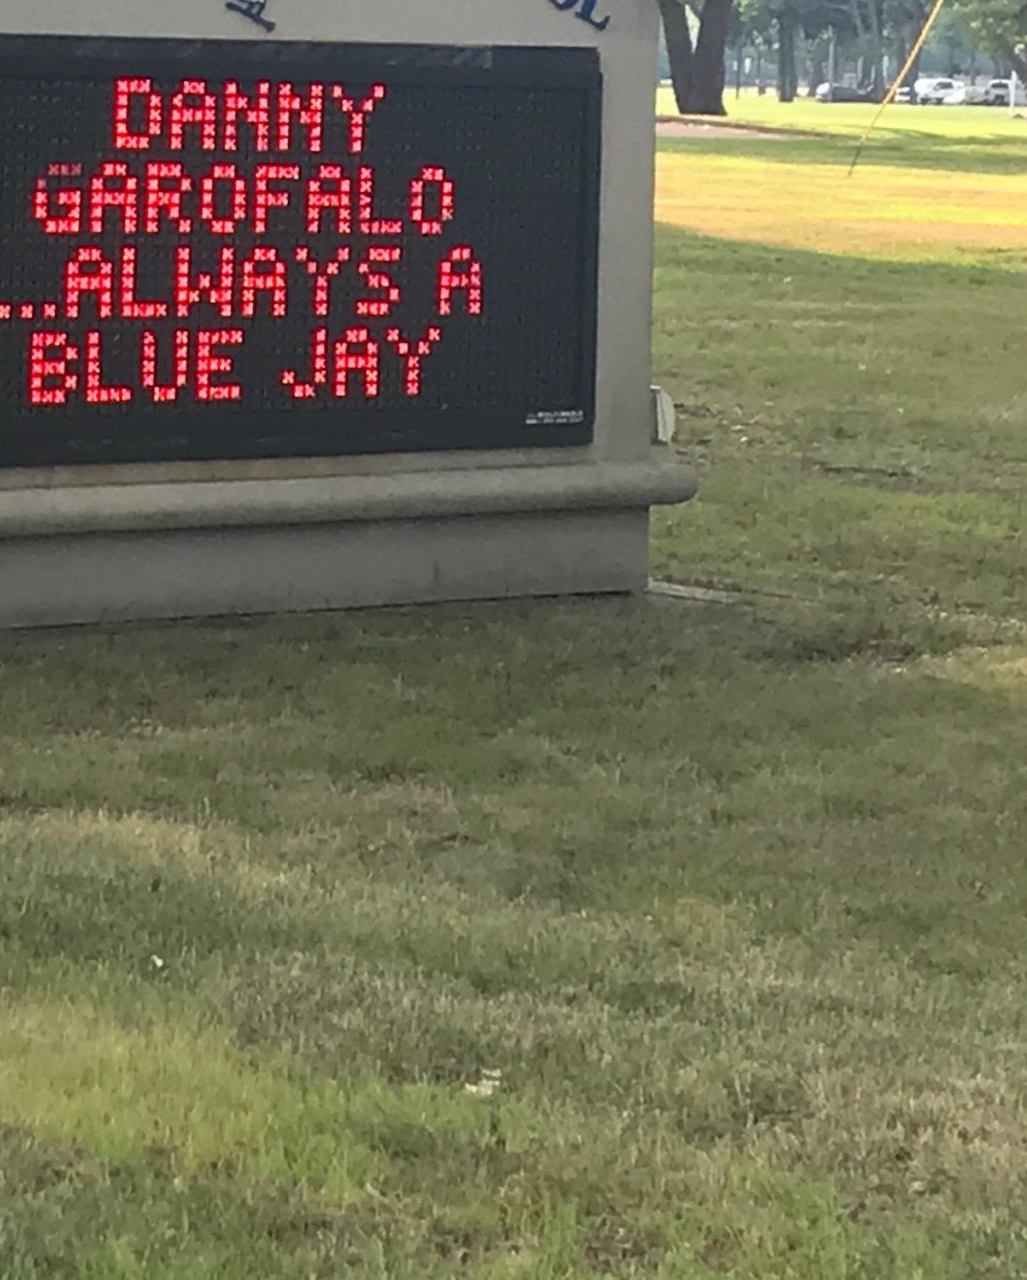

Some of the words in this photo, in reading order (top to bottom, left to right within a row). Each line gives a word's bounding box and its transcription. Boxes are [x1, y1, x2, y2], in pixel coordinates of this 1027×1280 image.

[114, 77, 385, 153] DANNY
[33, 162, 455, 235] GAROFALO
[437, 246, 483, 317] A
[29, 329, 244, 405] BLUE
[281, 327, 442, 399] JAY
